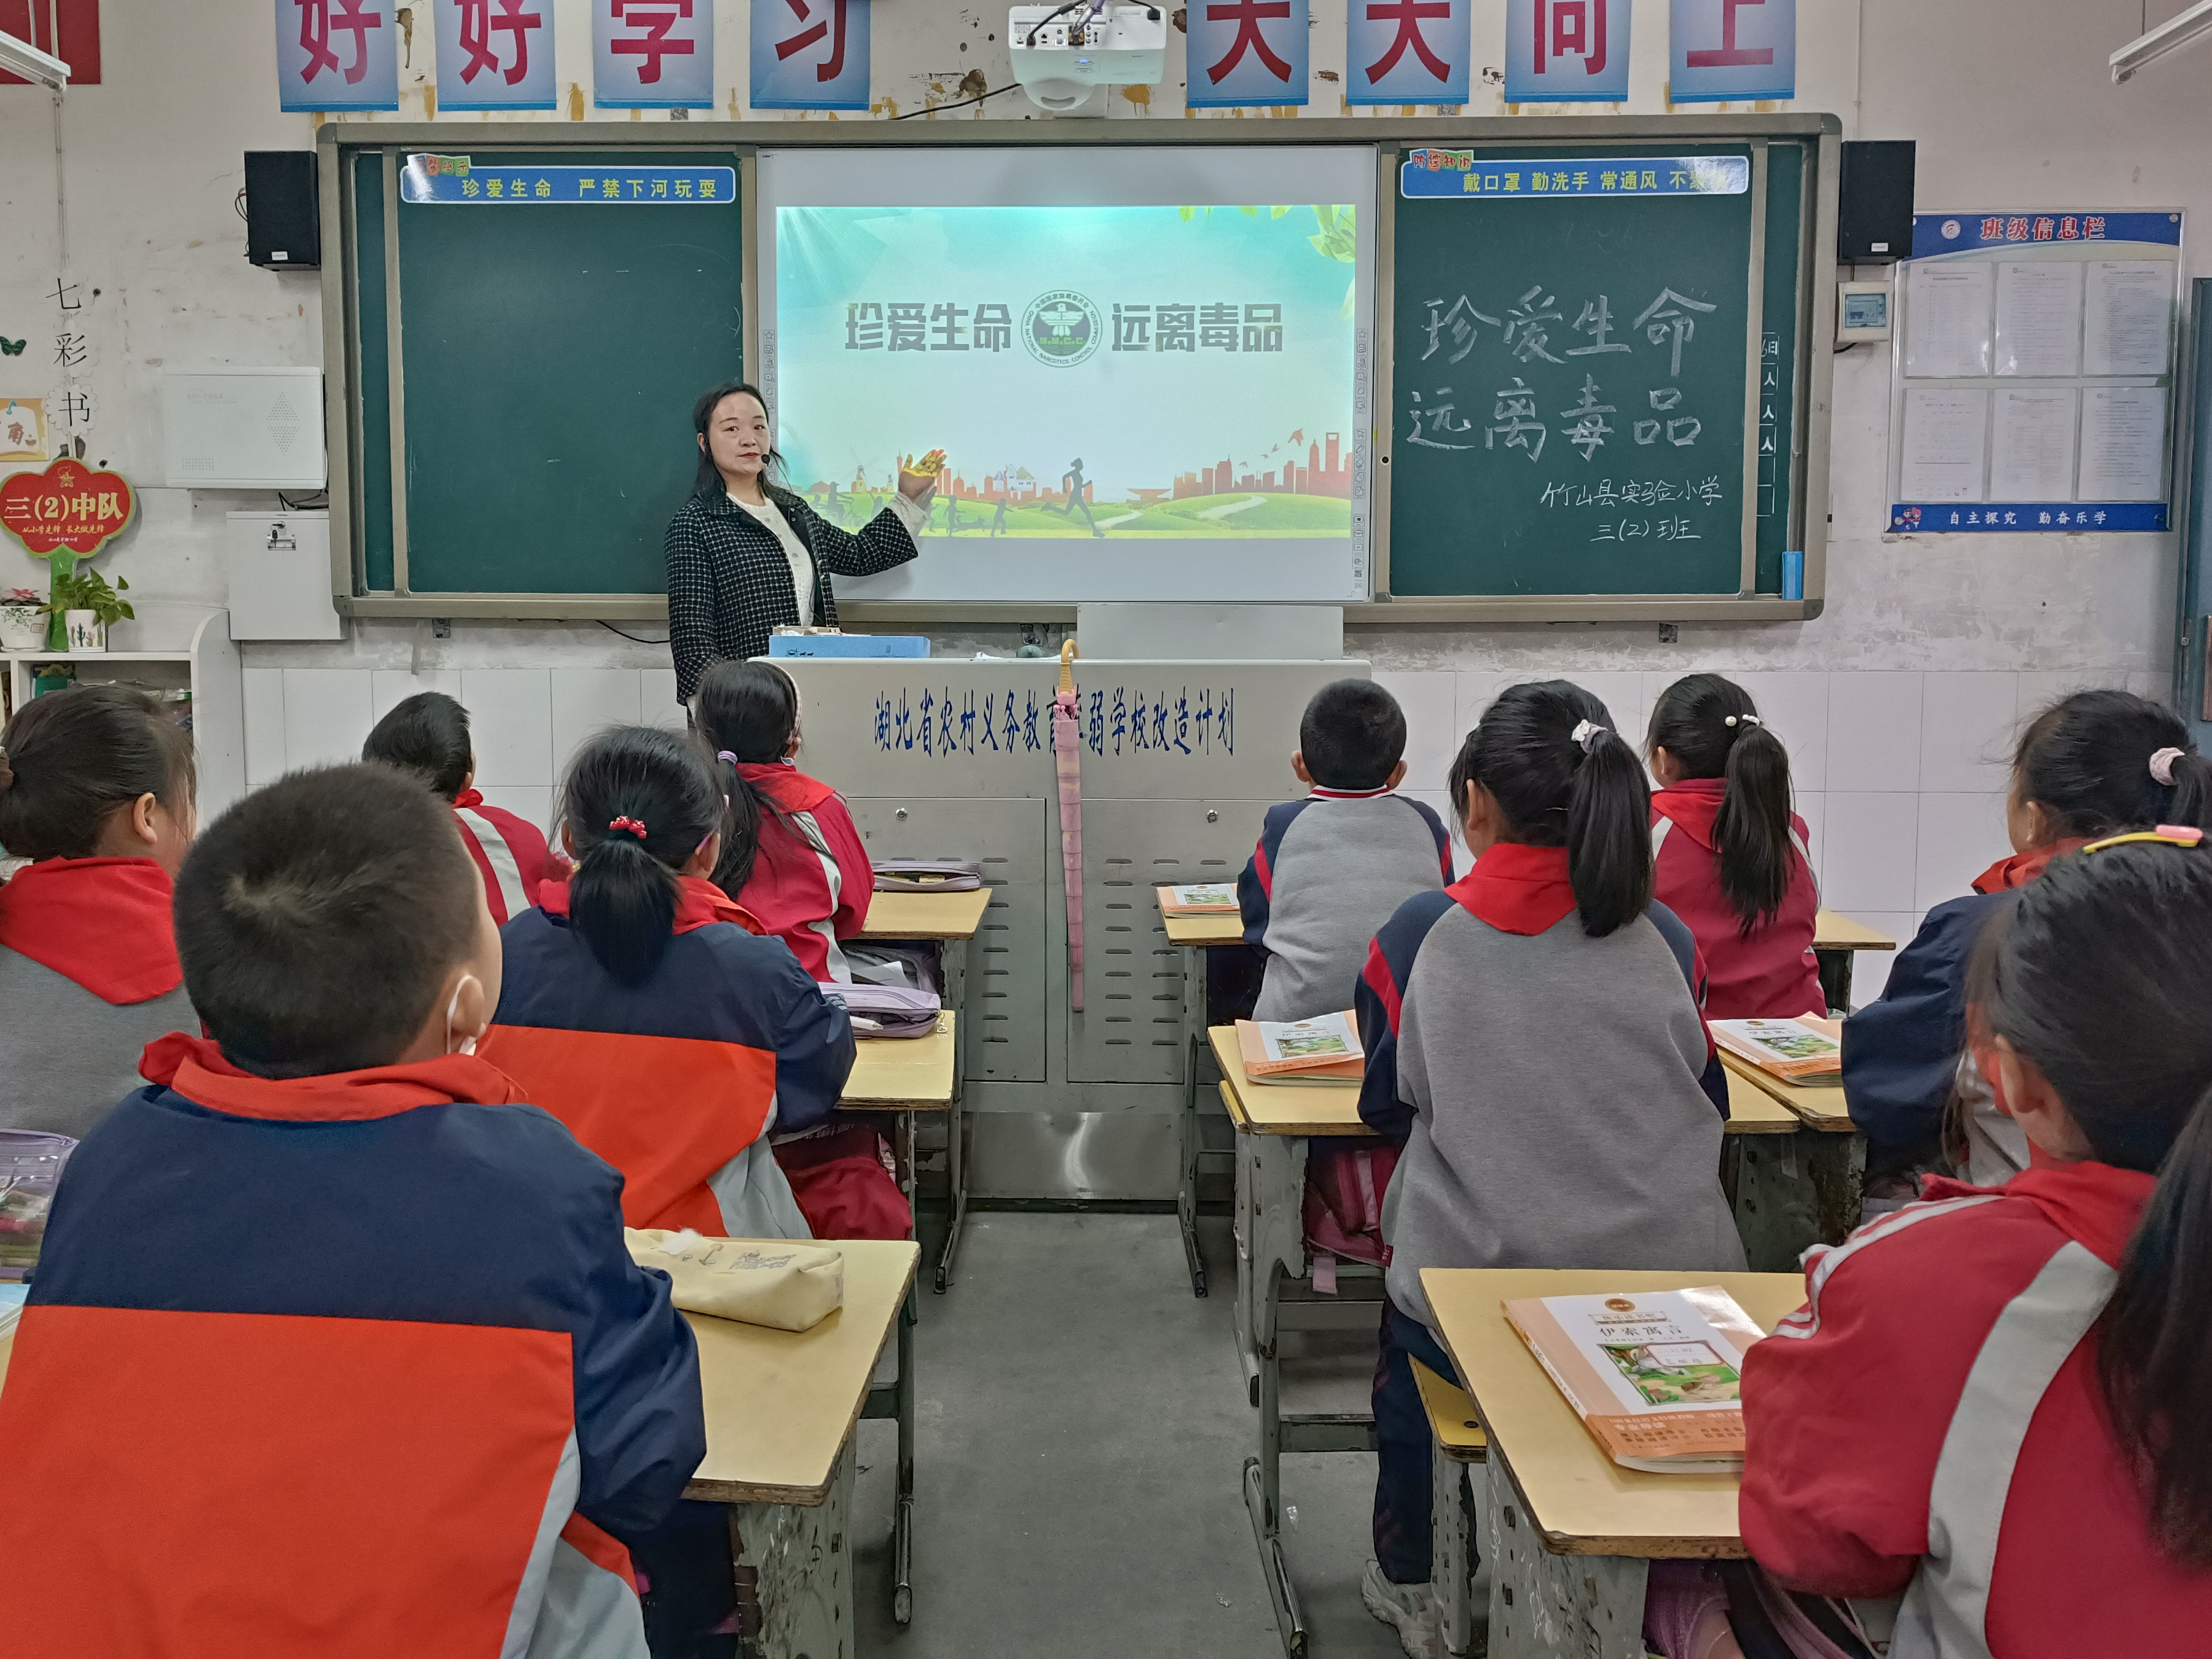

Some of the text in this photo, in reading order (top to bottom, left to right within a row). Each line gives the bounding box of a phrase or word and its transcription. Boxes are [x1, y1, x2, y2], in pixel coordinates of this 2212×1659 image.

[418, 158, 467, 174] 馨提示
[1413, 154, 1470, 168] 防控知识
[462, 178, 716, 198] 珍爱生命 严禁下河玩耍
[1463, 173, 1520, 192] 戴口罩
[1532, 171, 1590, 191] 勤洗手
[1601, 170, 1657, 190] 常通风
[1980, 216, 2106, 240] 班级信息栏
[845, 302, 1283, 353] 珍爱生命 远离毒品
[1421, 285, 1718, 377] 珍爱生命
[46, 277, 91, 427] 七彩书
[1025, 328, 1038, 355] NATIONAL
[1038, 353, 1070, 364] NARCOTICS
[1071, 346, 1093, 363] CONTROL
[1406, 374, 1701, 463] 远离毒品
[1539, 475, 1722, 507] 竹山县实验小学
[4, 492, 124, 522] 三(2)中队
[1950, 511, 2107, 525] 自主探究 勤奋乐学
[1590, 515, 1701, 541] 三(2)班
[874, 683, 1234, 758] 湖北省农村义务教弱学校改造计划
